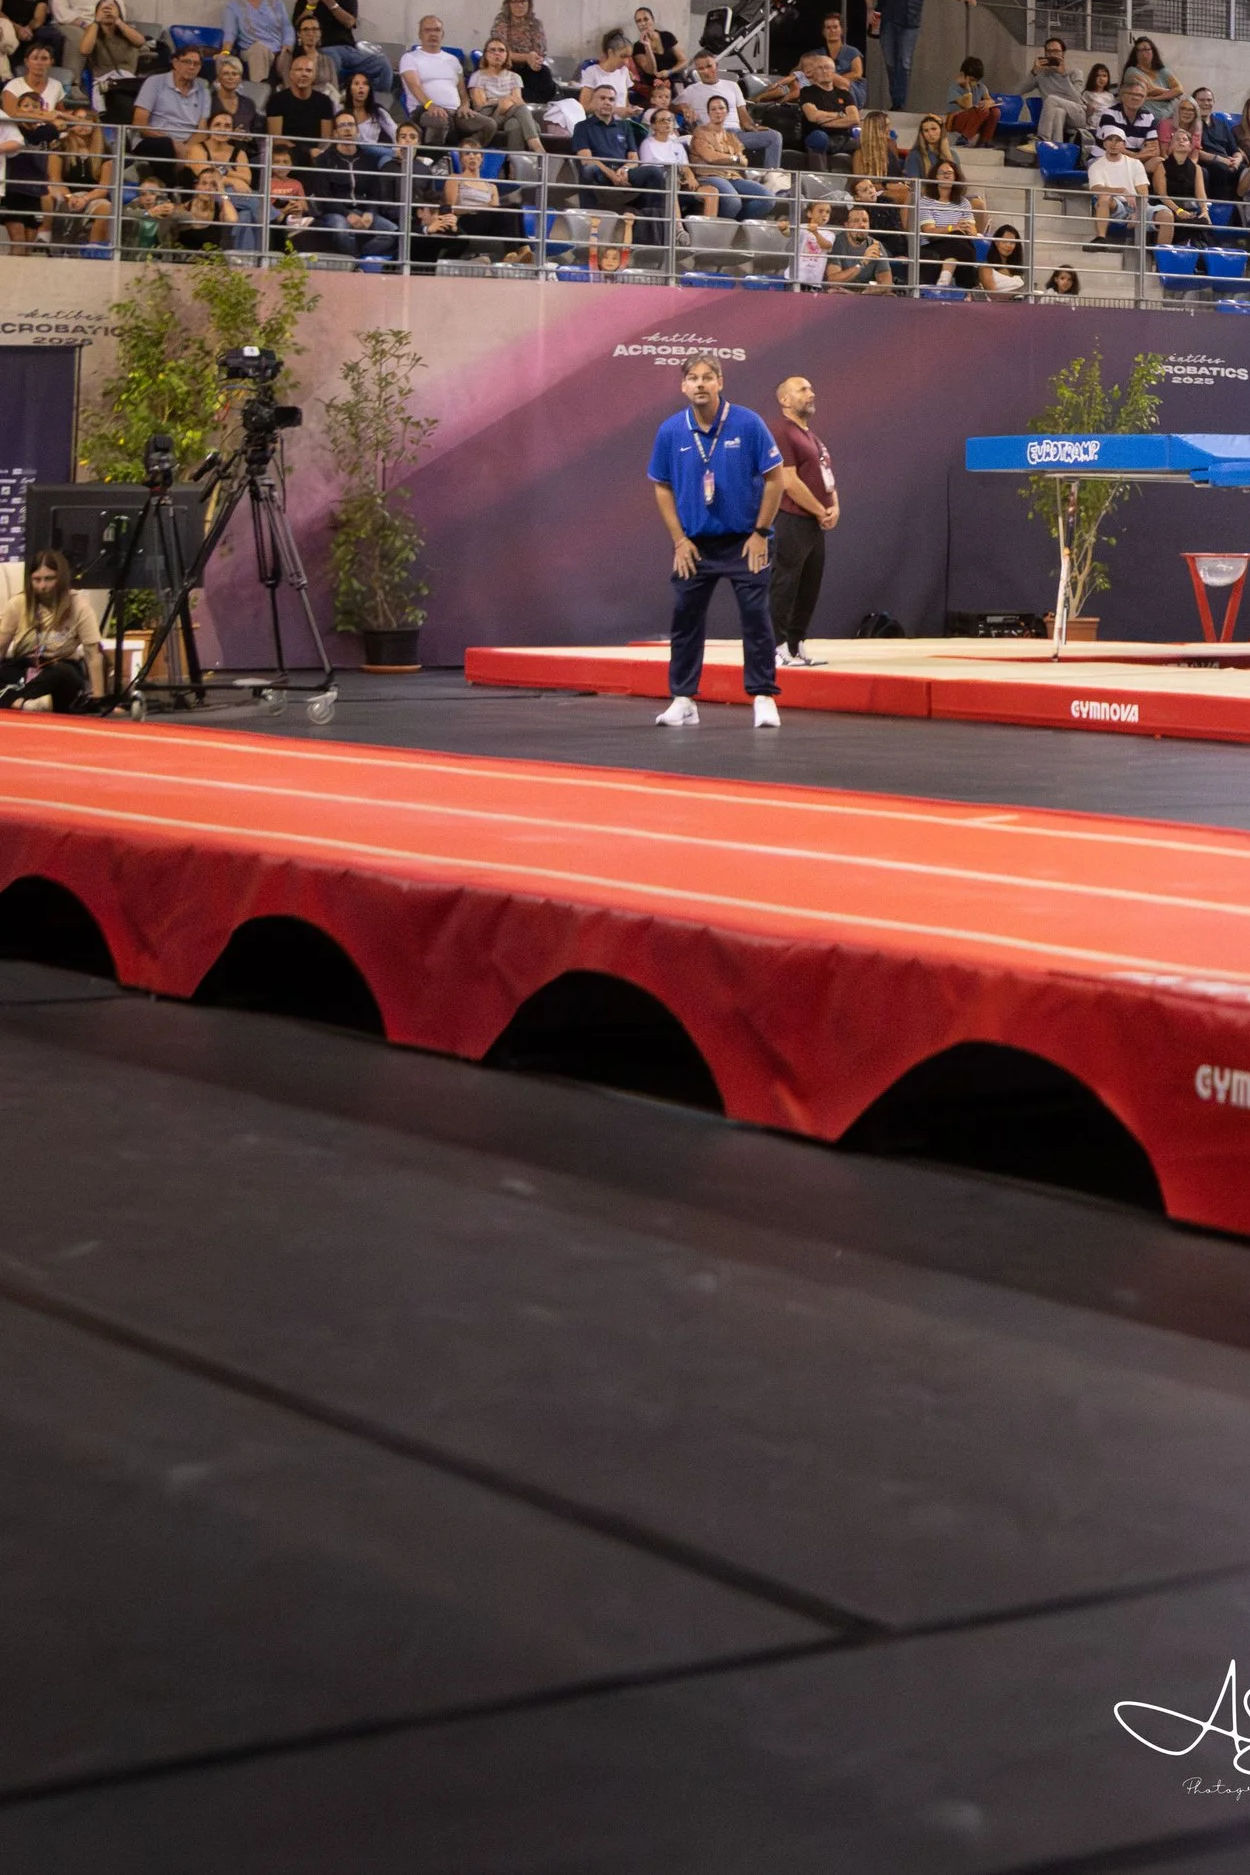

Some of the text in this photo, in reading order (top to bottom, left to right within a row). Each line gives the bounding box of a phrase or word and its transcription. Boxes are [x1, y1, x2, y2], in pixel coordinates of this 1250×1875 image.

[0, 323, 128, 338] CROBATIC
[612, 344, 747, 362] ACROBATICS
[1158, 365, 1249, 381] ROBATICS
[1171, 376, 1215, 385] 2025
[1070, 700, 1139, 723] GYMNOVA
